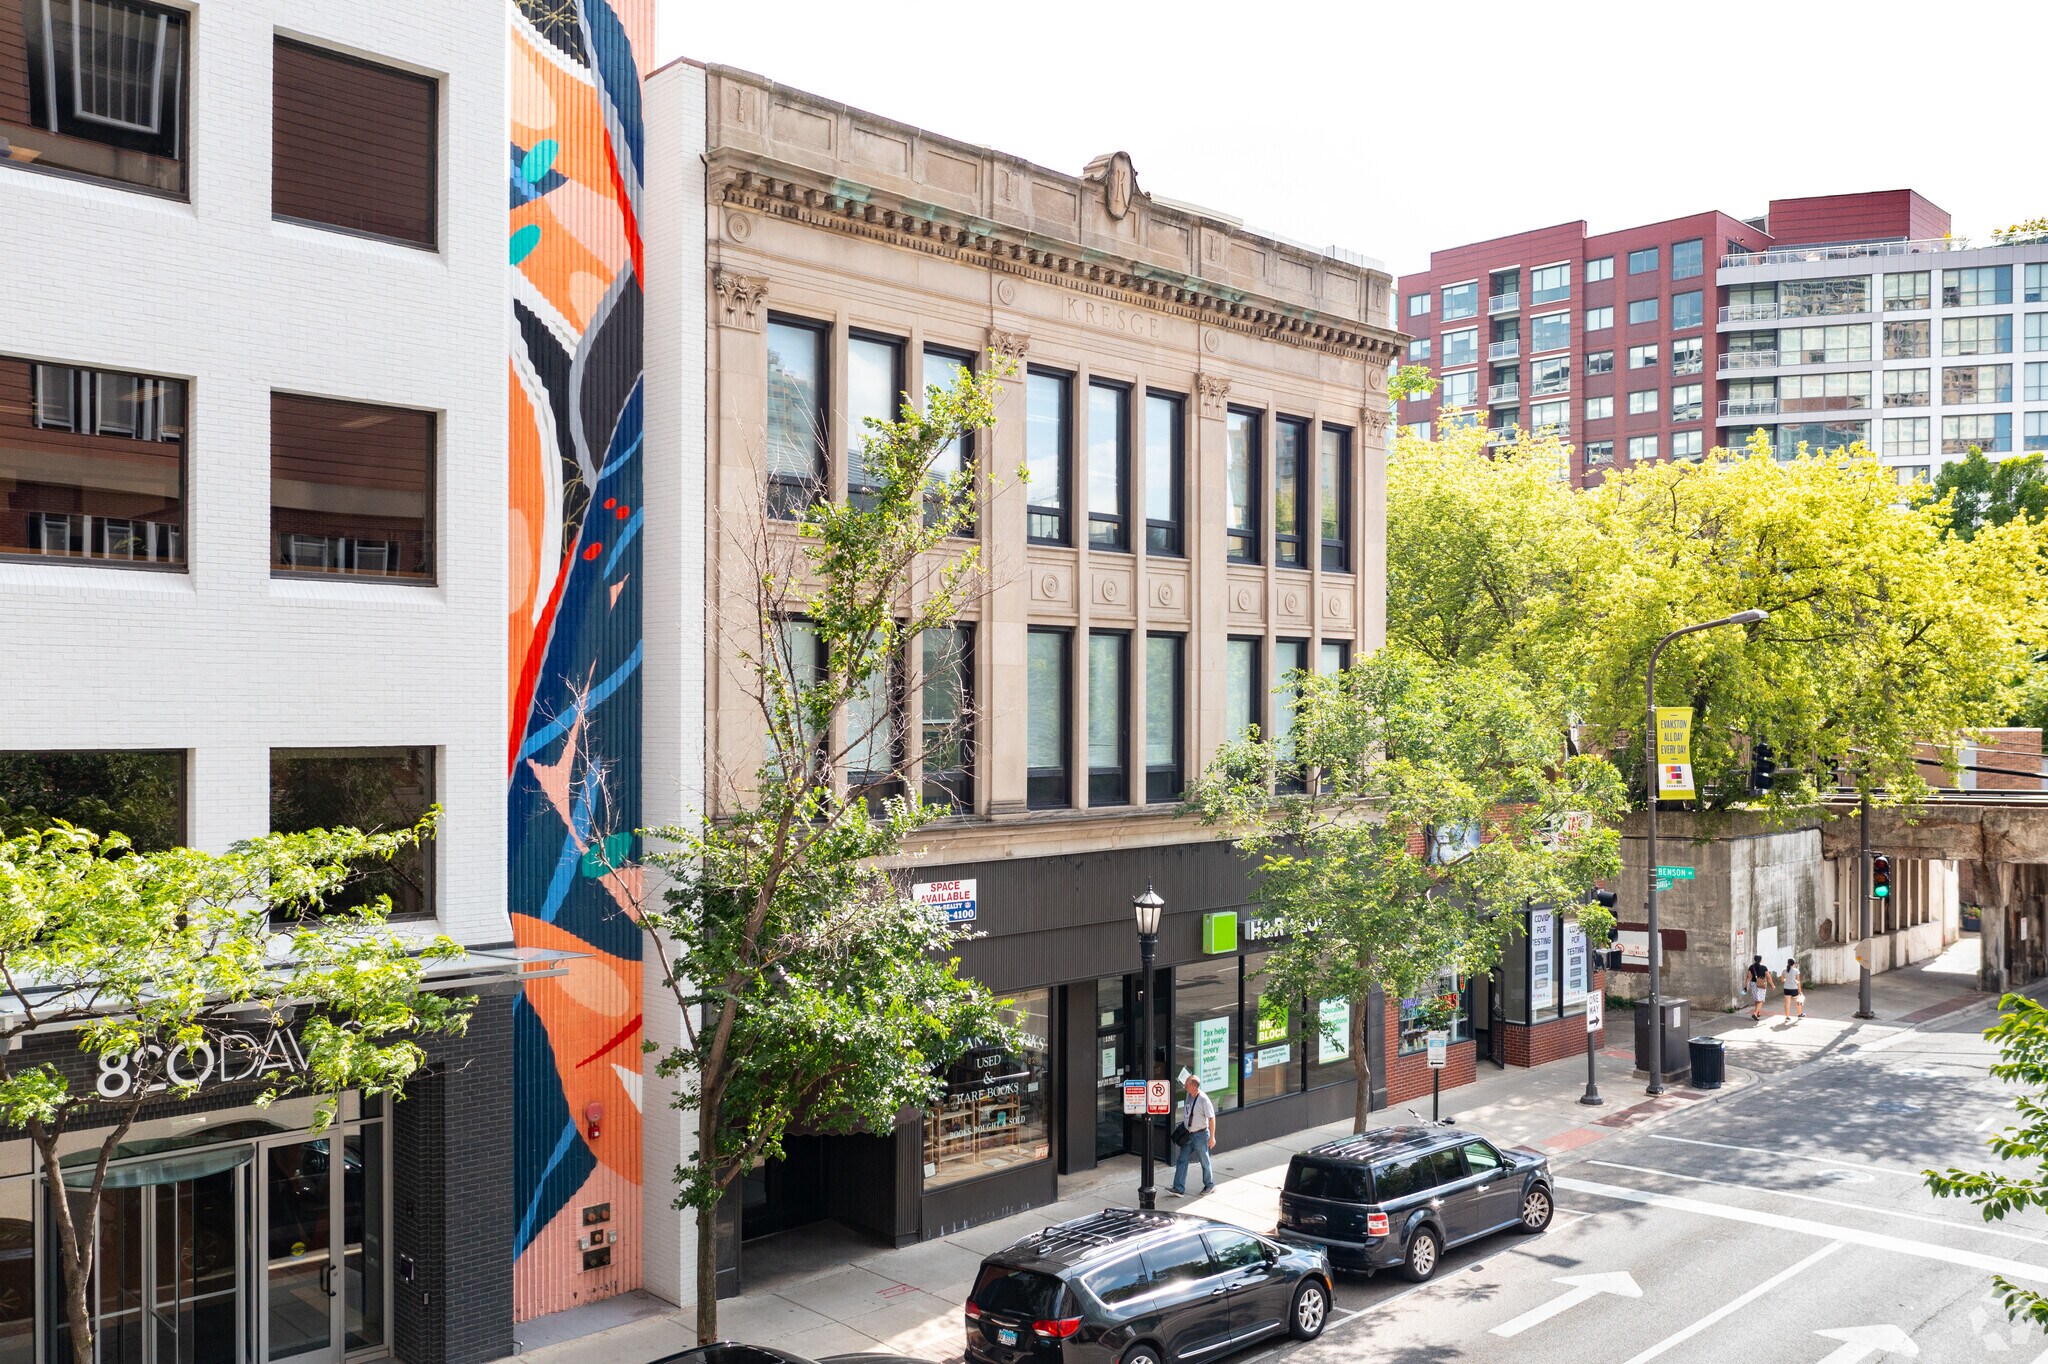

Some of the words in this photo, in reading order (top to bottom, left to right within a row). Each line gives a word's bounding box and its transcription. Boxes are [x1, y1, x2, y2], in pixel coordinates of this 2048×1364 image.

[1115, 170, 1129, 208] K
[1067, 297, 1159, 339] KRESGE
[1660, 720, 1687, 729] EVANSTON
[1664, 732, 1673, 741] ALL
[1674, 732, 1683, 741] DAY
[1661, 744, 1676, 754] EVERY
[1678, 744, 1687, 754] DAY
[1658, 868, 1686, 876] BENSON
[930, 881, 960, 892] SPACE
[920, 890, 970, 904] AVAILABLE
[1567, 946, 1584, 956] TESTING
[1589, 994, 1598, 1004] ONE
[1590, 1005, 1599, 1014] WAY
[1214, 1027, 1226, 1036] help
[1259, 1027, 1286, 1042] BLOCK
[976, 1055, 1001, 1069] USED
[1203, 1056, 1216, 1064] year.
[97, 1042, 215, 1098] 820
[984, 1071, 995, 1085] &
[987, 1082, 1018, 1098] BOOKS
[950, 1128, 972, 1139] BOOKS
[974, 1120, 1001, 1134] BOUGHT
[1009, 1115, 1026, 1126] SOLD
